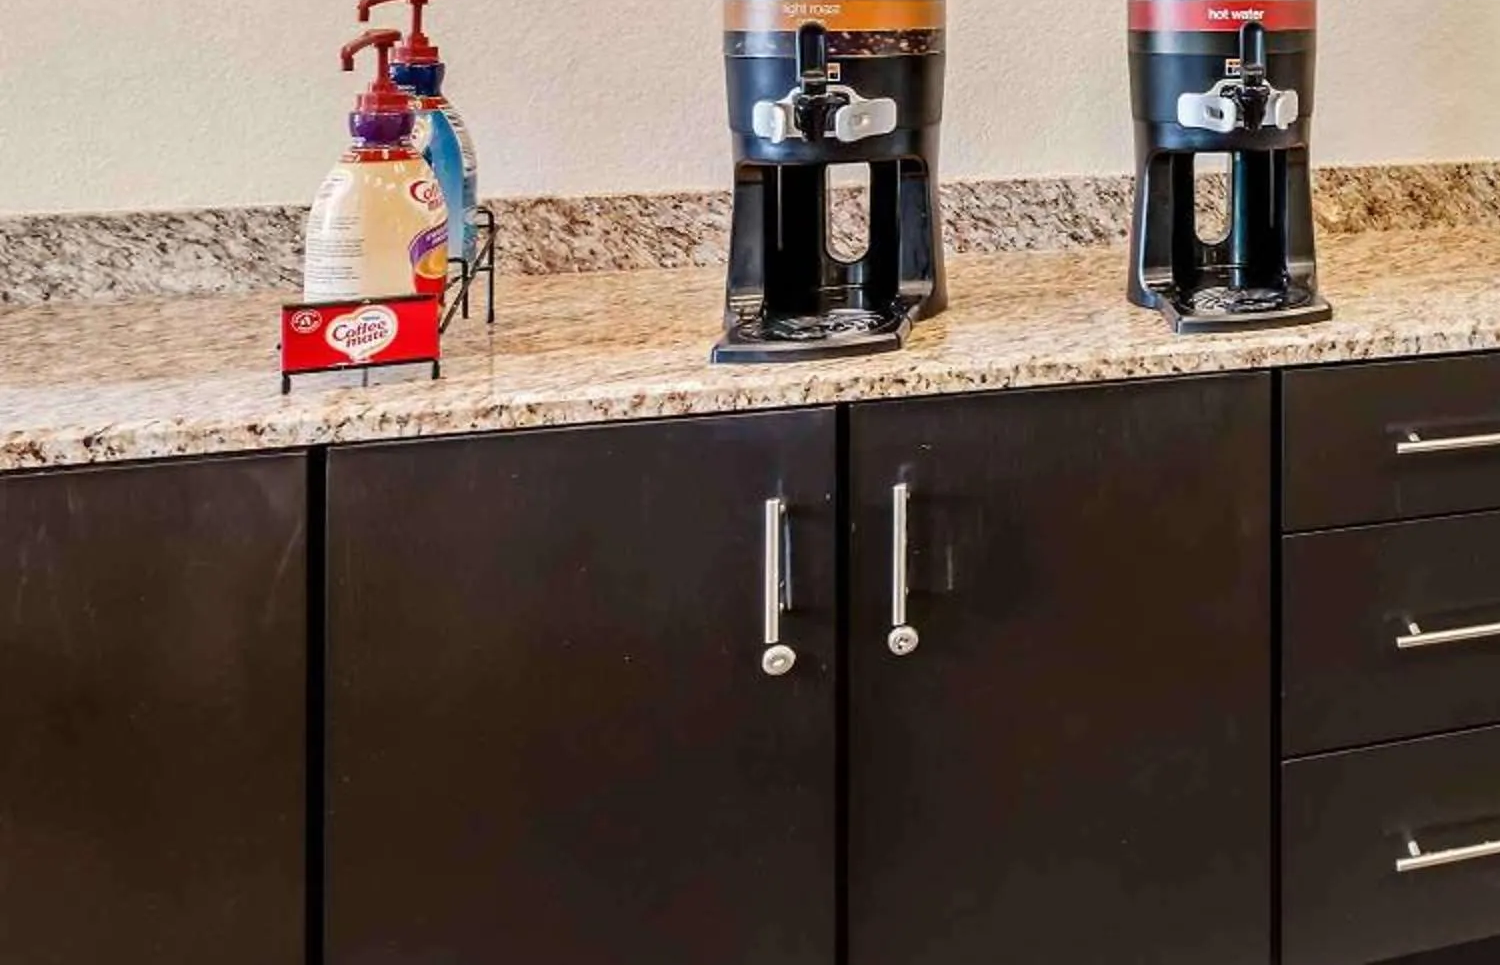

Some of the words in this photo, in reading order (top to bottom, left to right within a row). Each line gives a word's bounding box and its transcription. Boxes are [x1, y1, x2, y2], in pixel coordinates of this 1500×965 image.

[1208, 8, 1229, 20] hot
[1231, 8, 1265, 20] water
[332, 320, 387, 342] Coffee
[345, 329, 389, 348] mate
